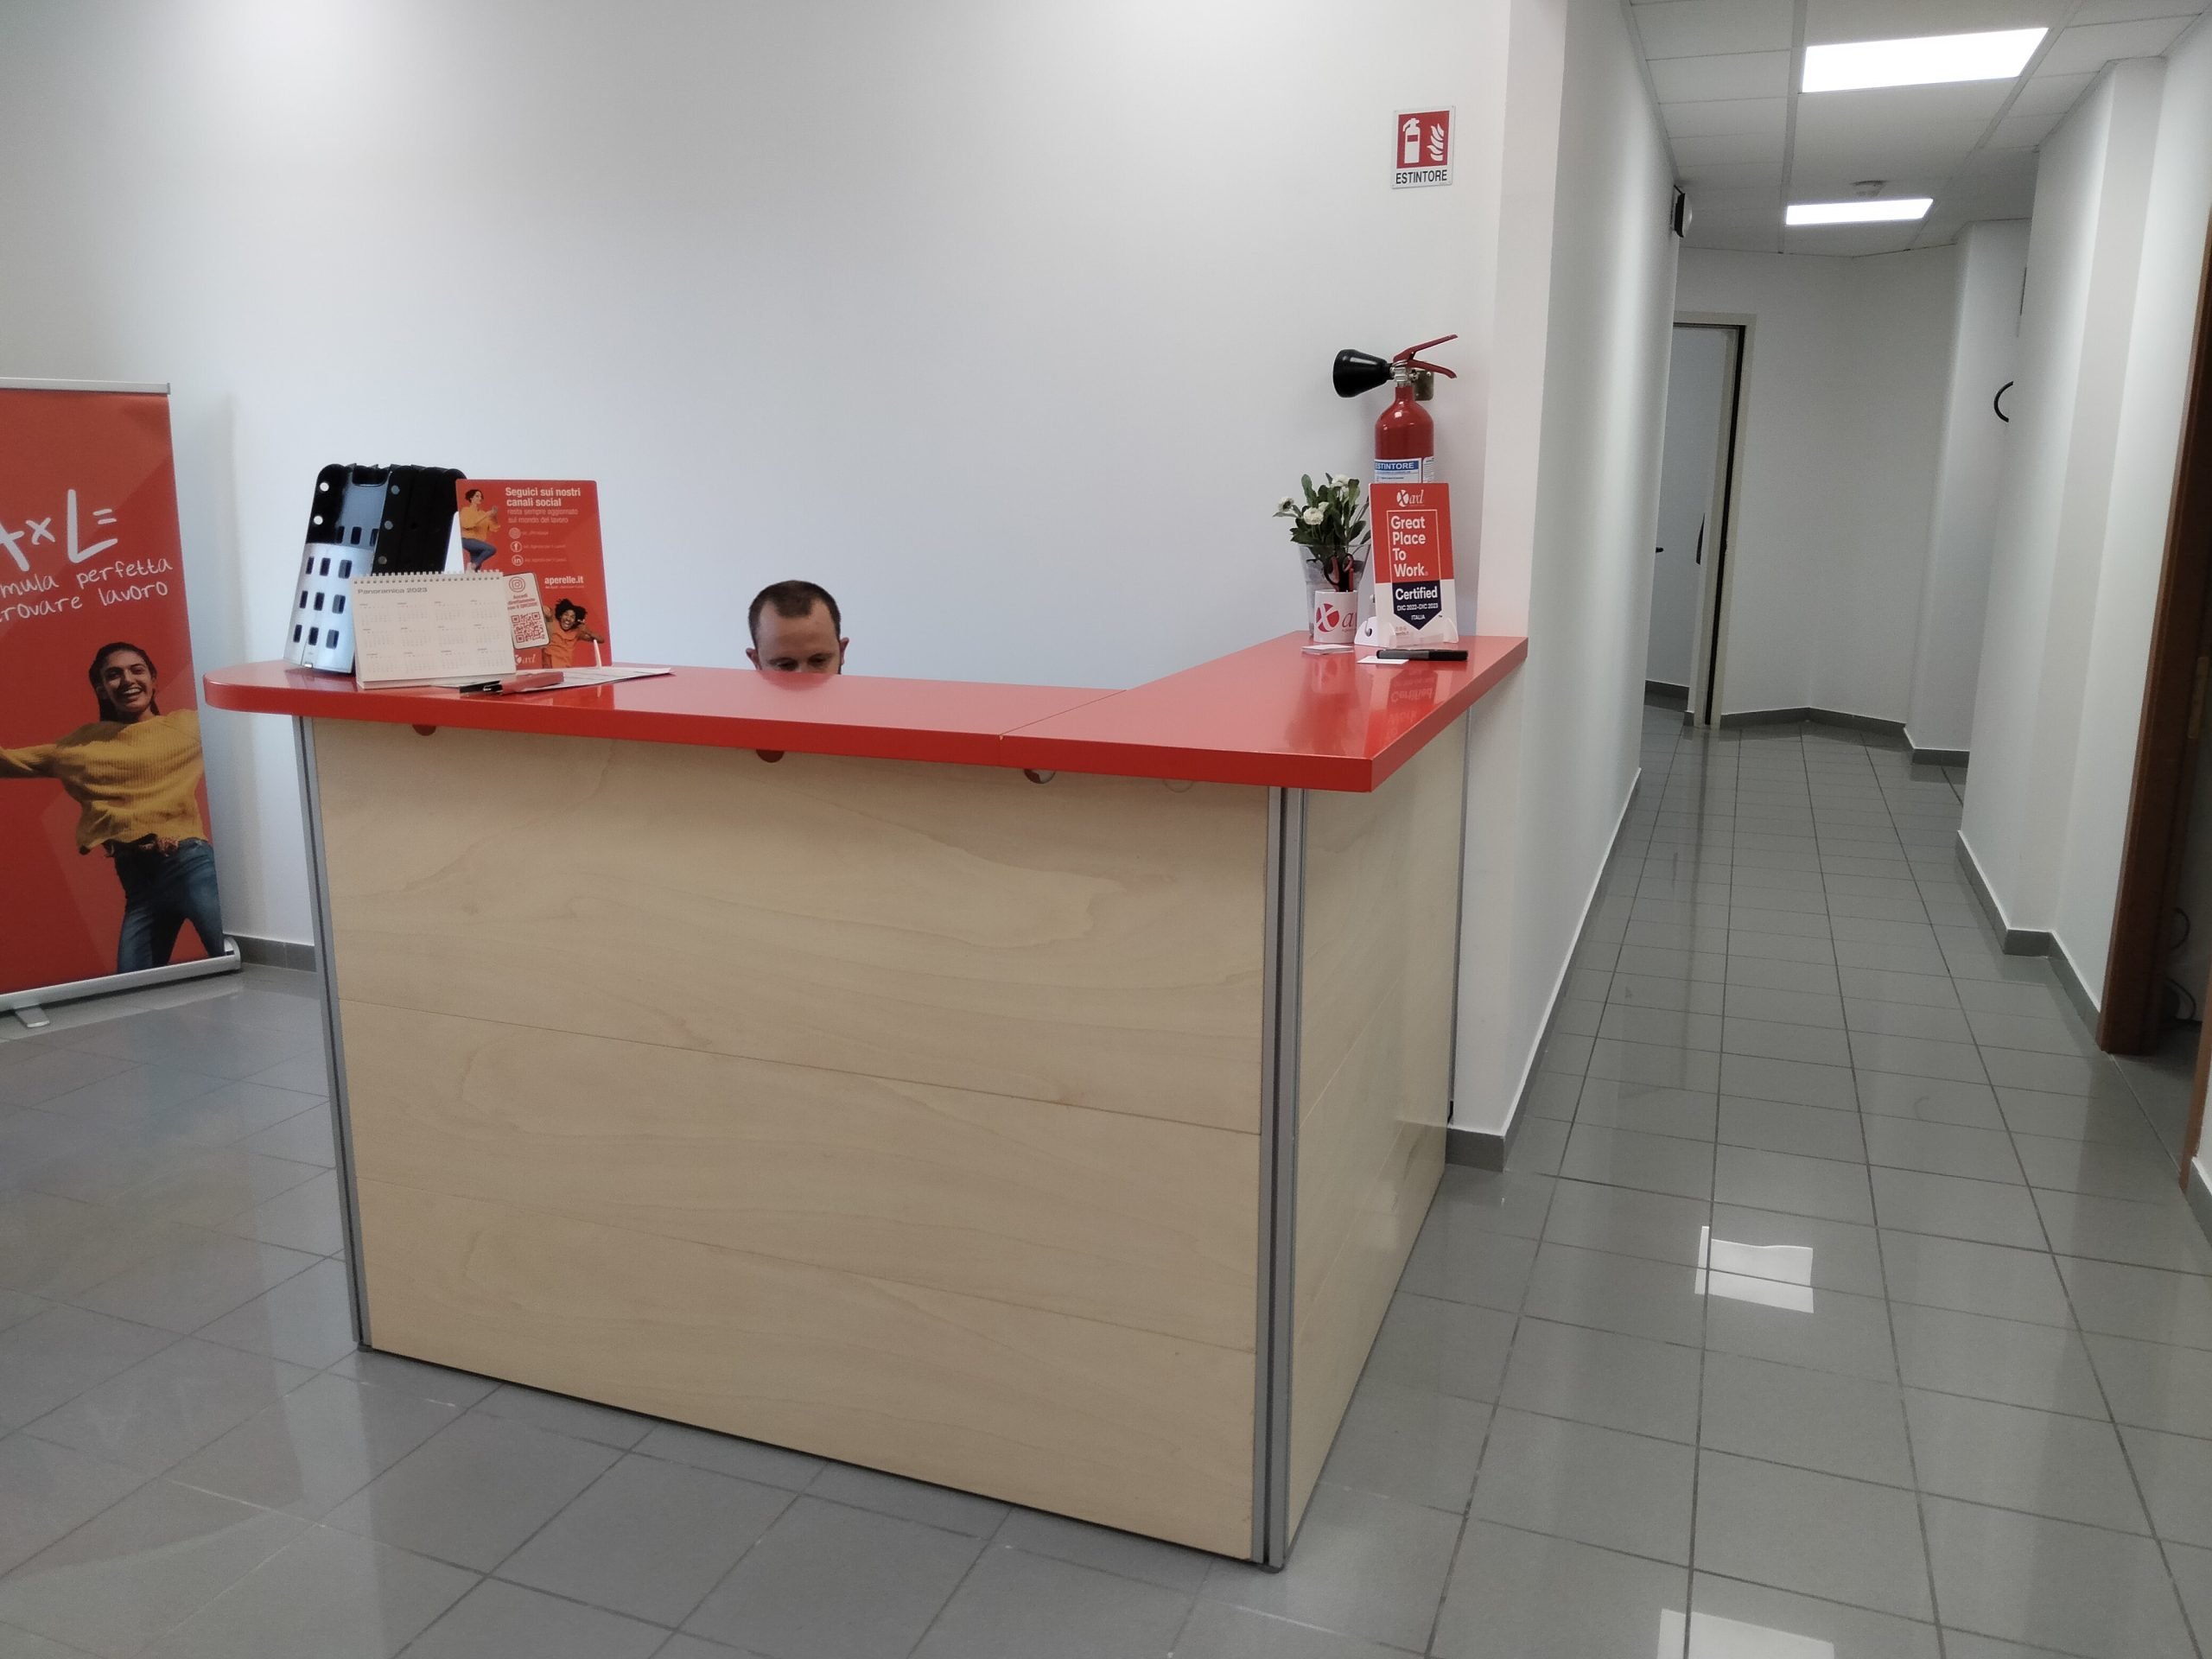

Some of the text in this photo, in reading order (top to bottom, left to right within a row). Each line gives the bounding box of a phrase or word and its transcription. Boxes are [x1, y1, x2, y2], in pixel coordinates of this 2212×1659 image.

[1395, 169, 1447, 184] ESTINTORE
[505, 487, 581, 498] Seguici sui nostri
[506, 498, 562, 506] canali social
[1390, 515, 1426, 530] Great
[1392, 531, 1427, 545] Place
[1392, 548, 1407, 561] To
[76, 558, 173, 590] perfetta
[544, 575, 584, 586] aperelle.it
[1395, 586, 1438, 601] Certified
[0, 581, 168, 623] rovare lavoro
